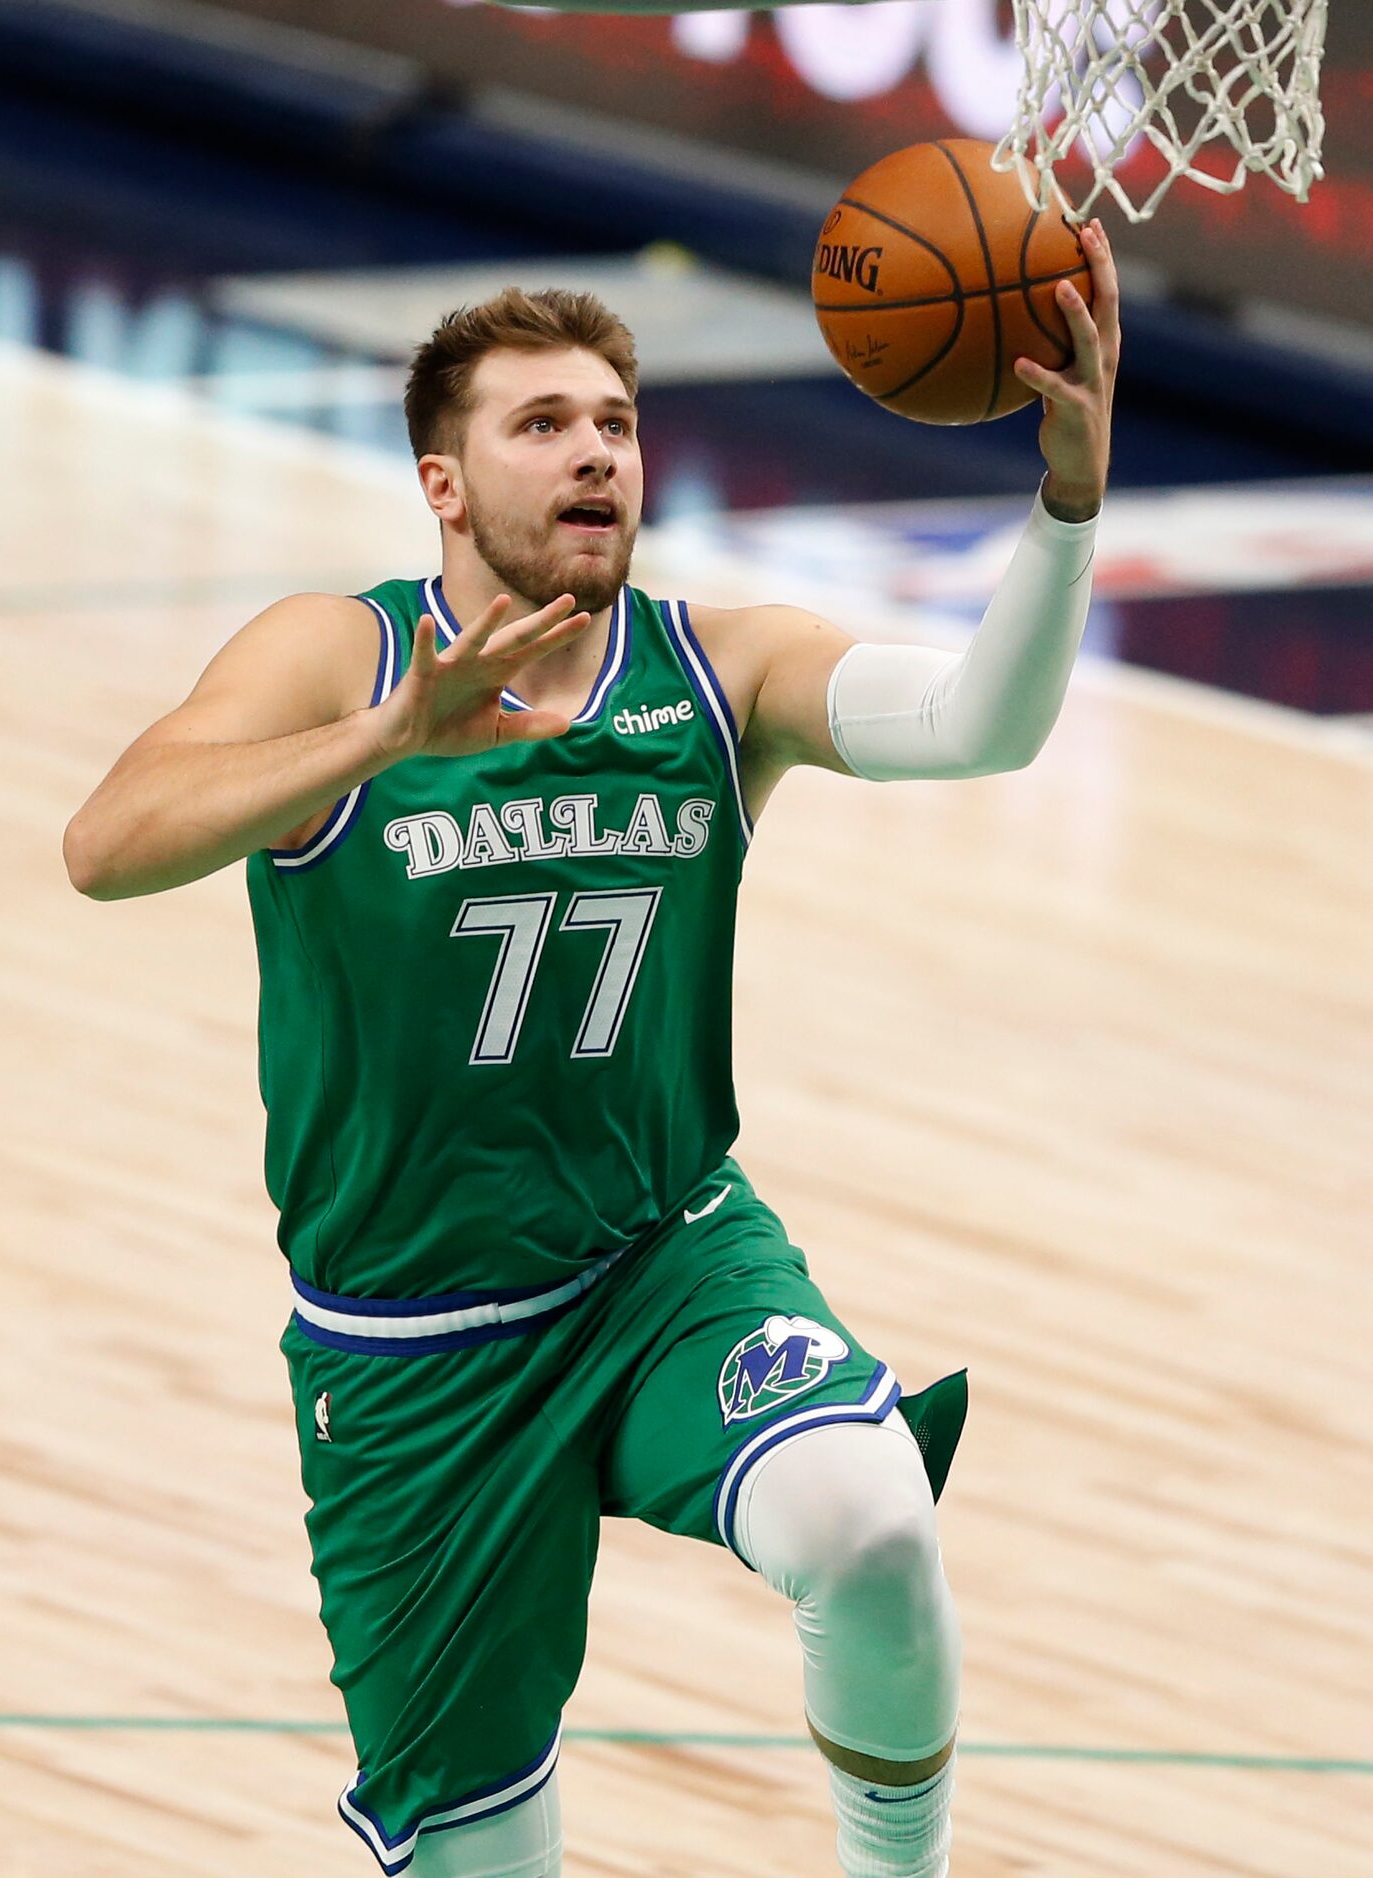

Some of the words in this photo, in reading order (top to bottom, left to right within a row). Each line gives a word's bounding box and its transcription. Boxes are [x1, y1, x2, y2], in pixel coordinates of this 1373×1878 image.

[817, 244, 883, 293] DING
[613, 699, 695, 737] chime
[383, 793, 717, 880] DALLAS
[449, 886, 664, 1066] 77
